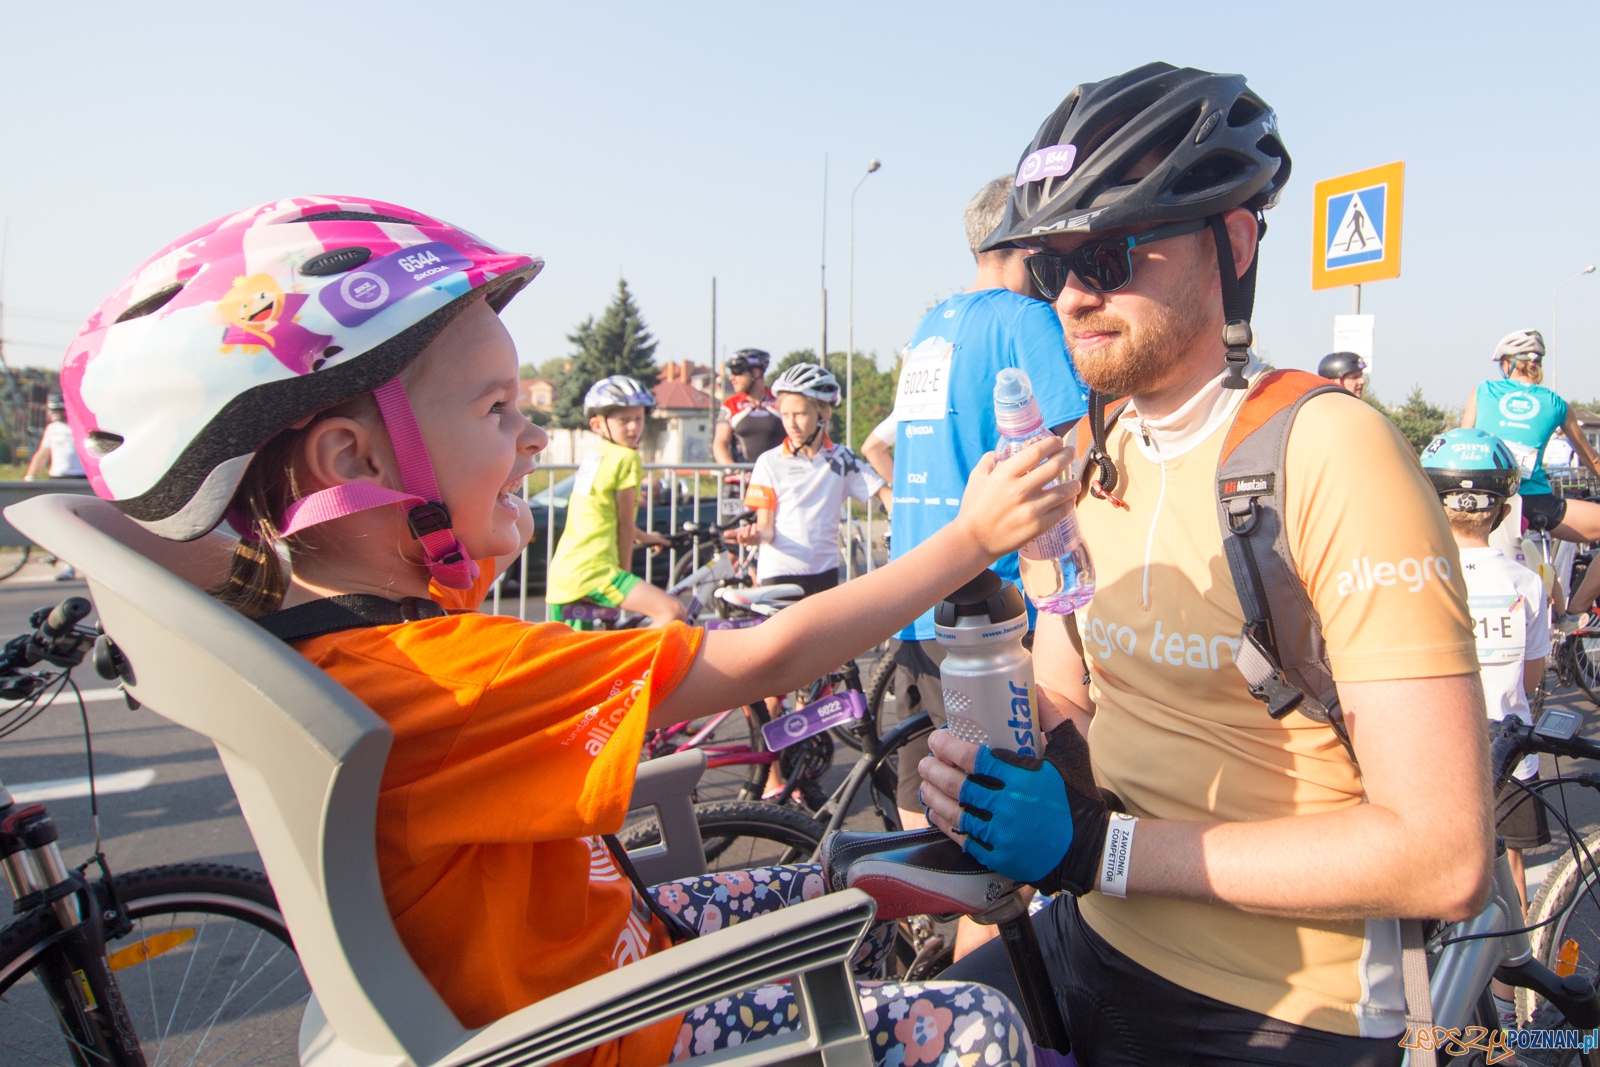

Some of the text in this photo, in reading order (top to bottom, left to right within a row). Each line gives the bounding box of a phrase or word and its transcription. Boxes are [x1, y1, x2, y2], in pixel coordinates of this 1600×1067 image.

[1032, 206, 1110, 235] MET
[397, 249, 442, 273] 6544
[412, 264, 450, 282] ŠKODA
[353, 281, 372, 294] BIKE
[904, 367, 941, 395] 6022-E
[1337, 555, 1452, 597] allegro
[606, 678, 624, 701] egro
[1105, 828, 1120, 883] COMPETITOR
[1116, 830, 1130, 877] ZAWODNIK
